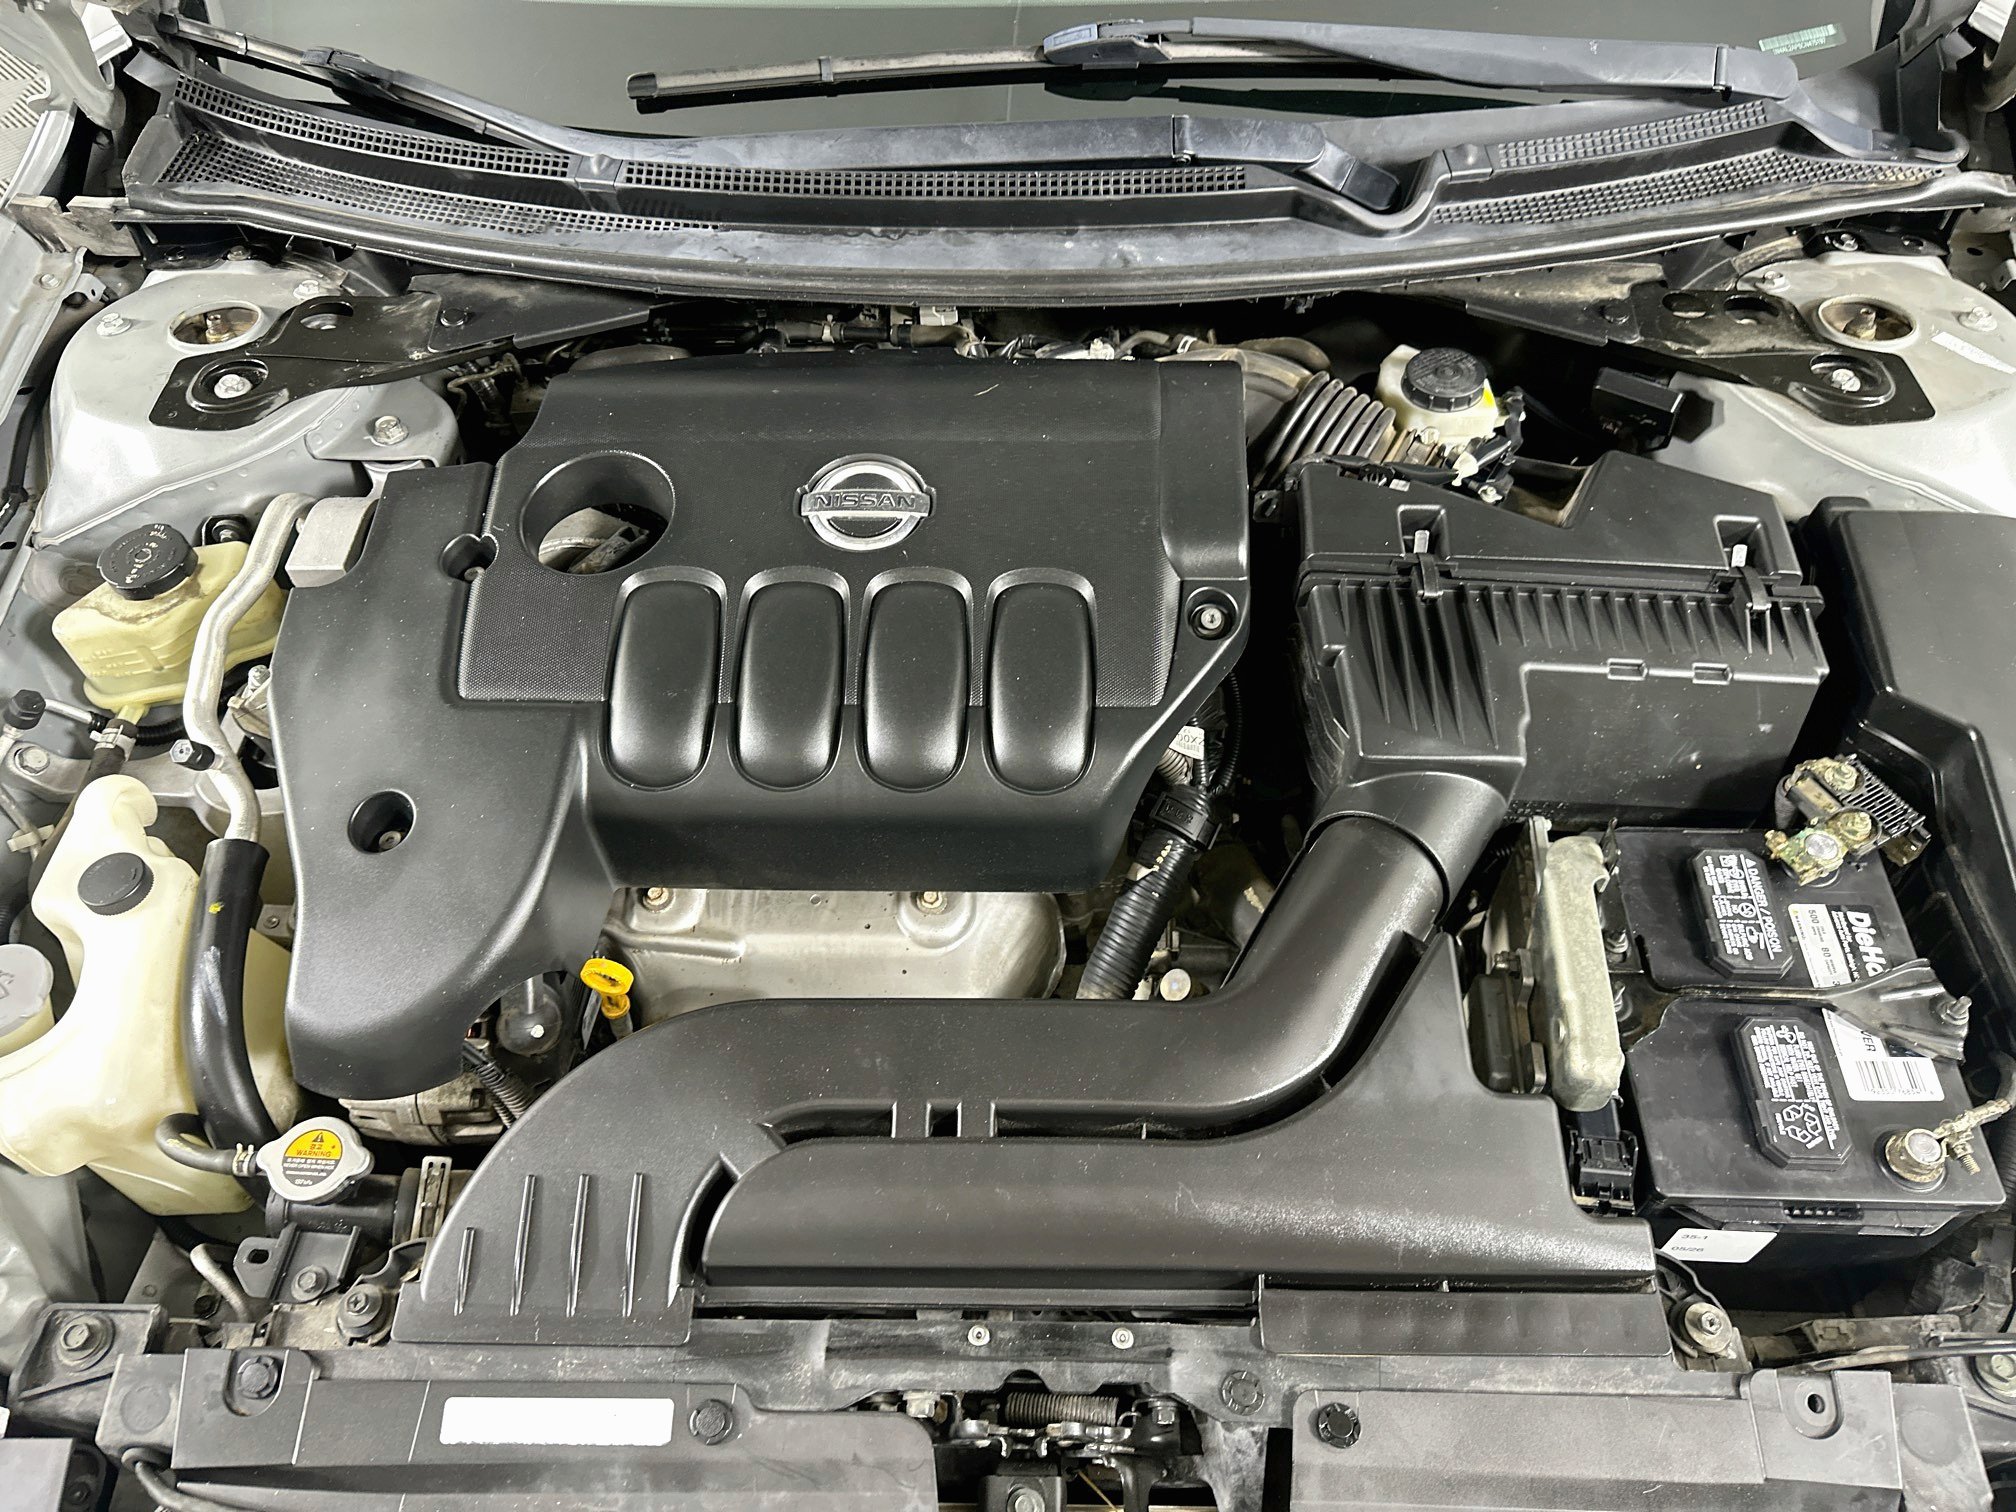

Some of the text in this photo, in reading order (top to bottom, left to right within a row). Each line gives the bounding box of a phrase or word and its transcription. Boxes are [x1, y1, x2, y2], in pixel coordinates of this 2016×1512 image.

[814, 493, 916, 509] NISSAN
[1748, 868, 1769, 907] DANGER
[1762, 916, 1783, 953] POISON
[1808, 910, 1820, 924] 500
[1846, 911, 1886, 977] DieHa
[1822, 947, 1832, 958] 80
[1860, 1030, 1876, 1052] VER
[296, 1149, 332, 1158] WARNING
